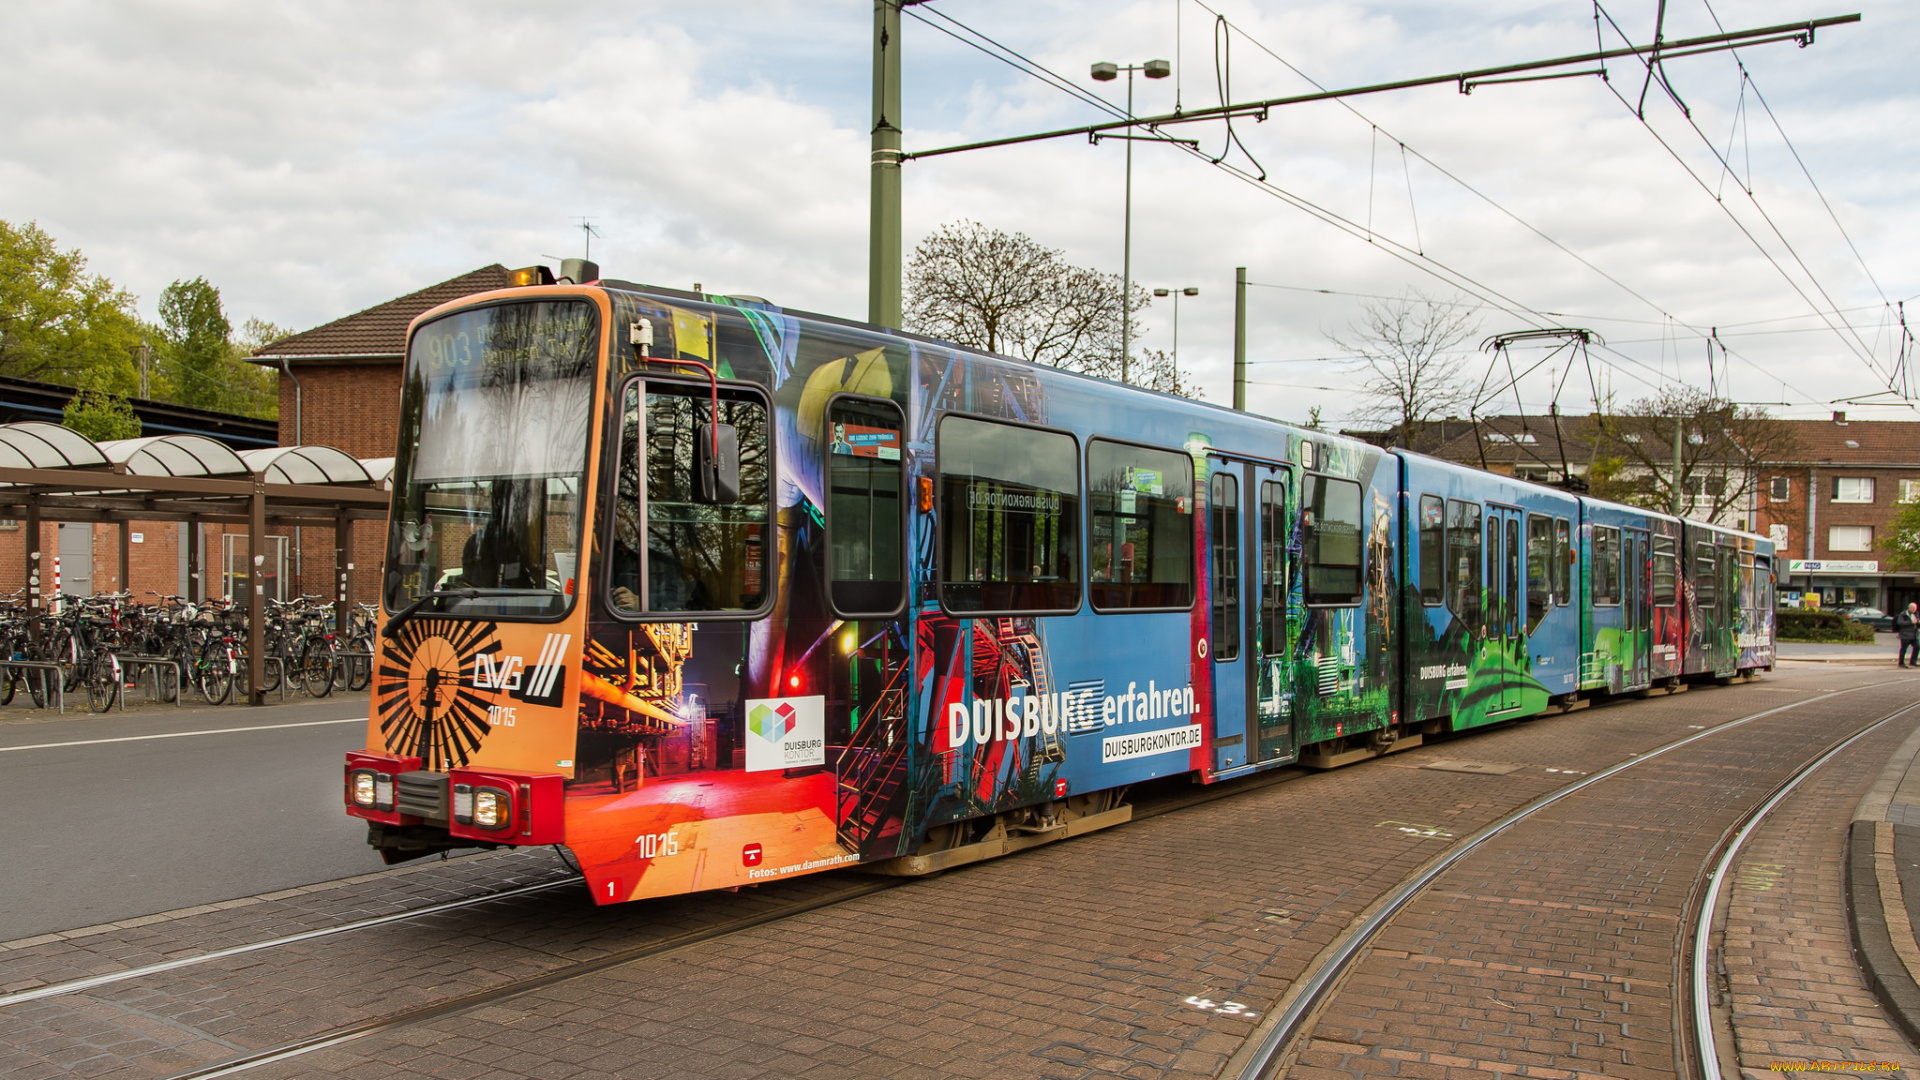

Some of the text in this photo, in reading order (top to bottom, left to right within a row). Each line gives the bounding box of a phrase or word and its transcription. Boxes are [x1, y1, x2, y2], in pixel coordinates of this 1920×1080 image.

[429, 331, 472, 369] 903
[473, 653, 523, 690] DVG
[487, 705, 517, 727] 1015
[949, 680, 1200, 748] DUISBURG erfahren.
[784, 739, 822, 751] DUISBURG
[784, 748, 815, 760] KONTOR
[1105, 728, 1200, 758] DUISBURGKONTOR.DE
[634, 831, 679, 859] 1015
[749, 852, 860, 879] Fotos: www.dammrath.com
[607, 881, 615, 897] 1
